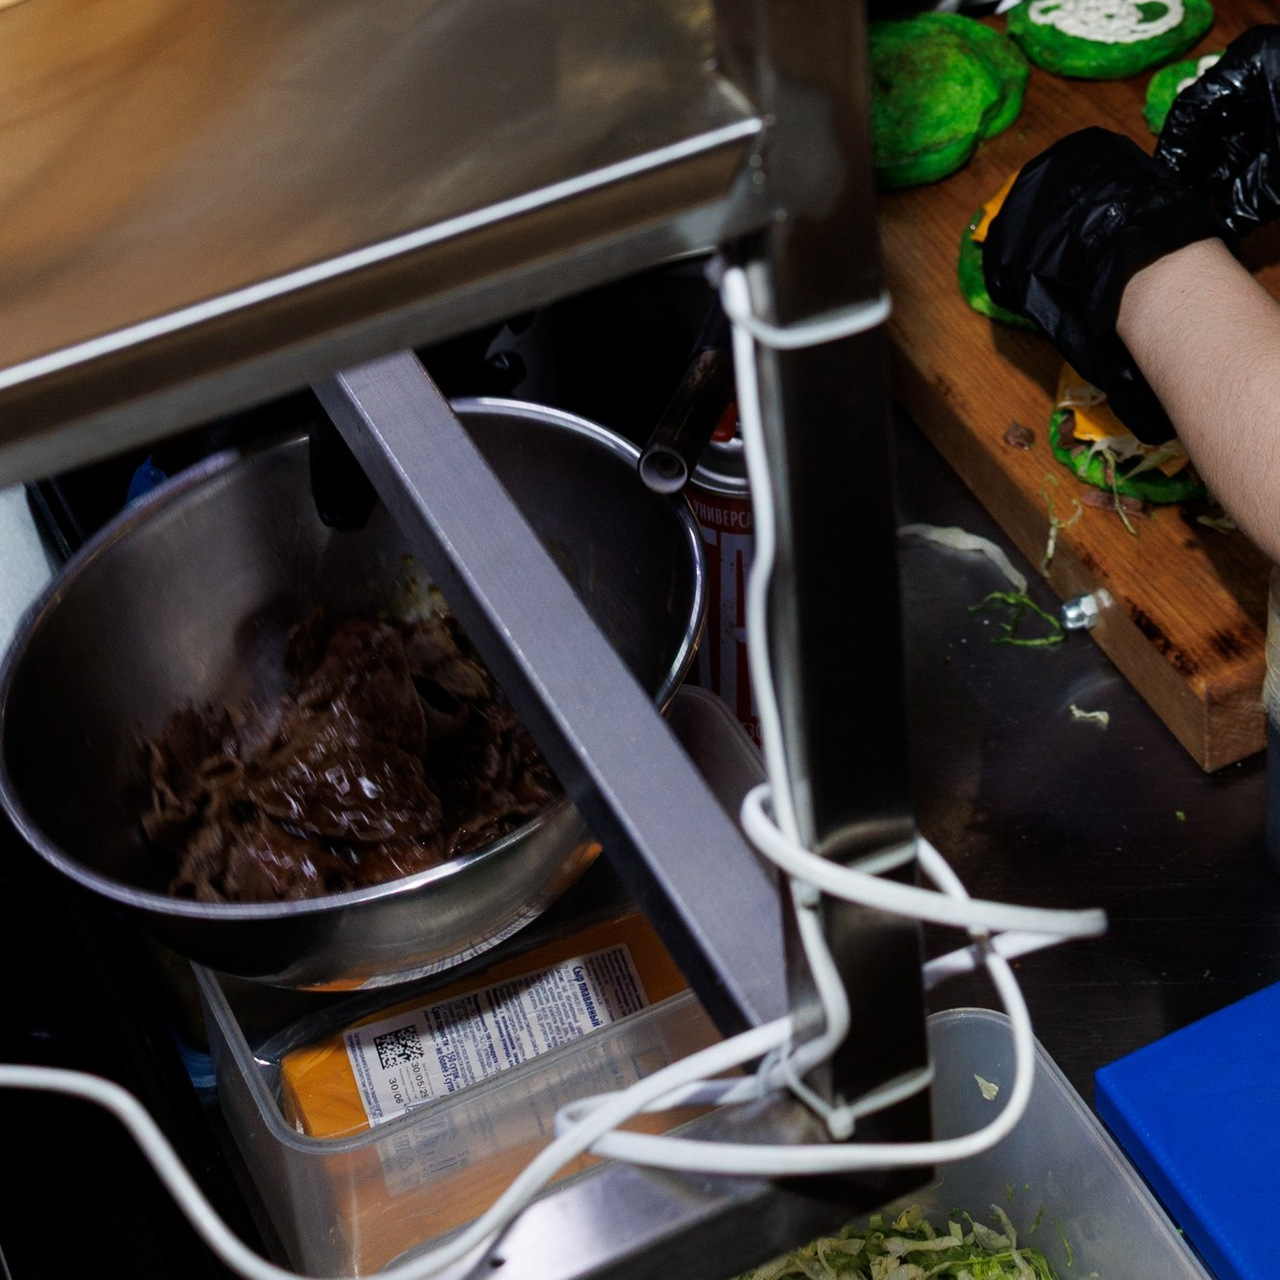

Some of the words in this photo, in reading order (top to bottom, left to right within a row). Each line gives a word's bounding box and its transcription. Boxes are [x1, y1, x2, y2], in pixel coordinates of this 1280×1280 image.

[570, 964, 587, 983] Сыр
[578, 980, 603, 1027] плавленый
[409, 1061, 430, 1099] 30/05/25
